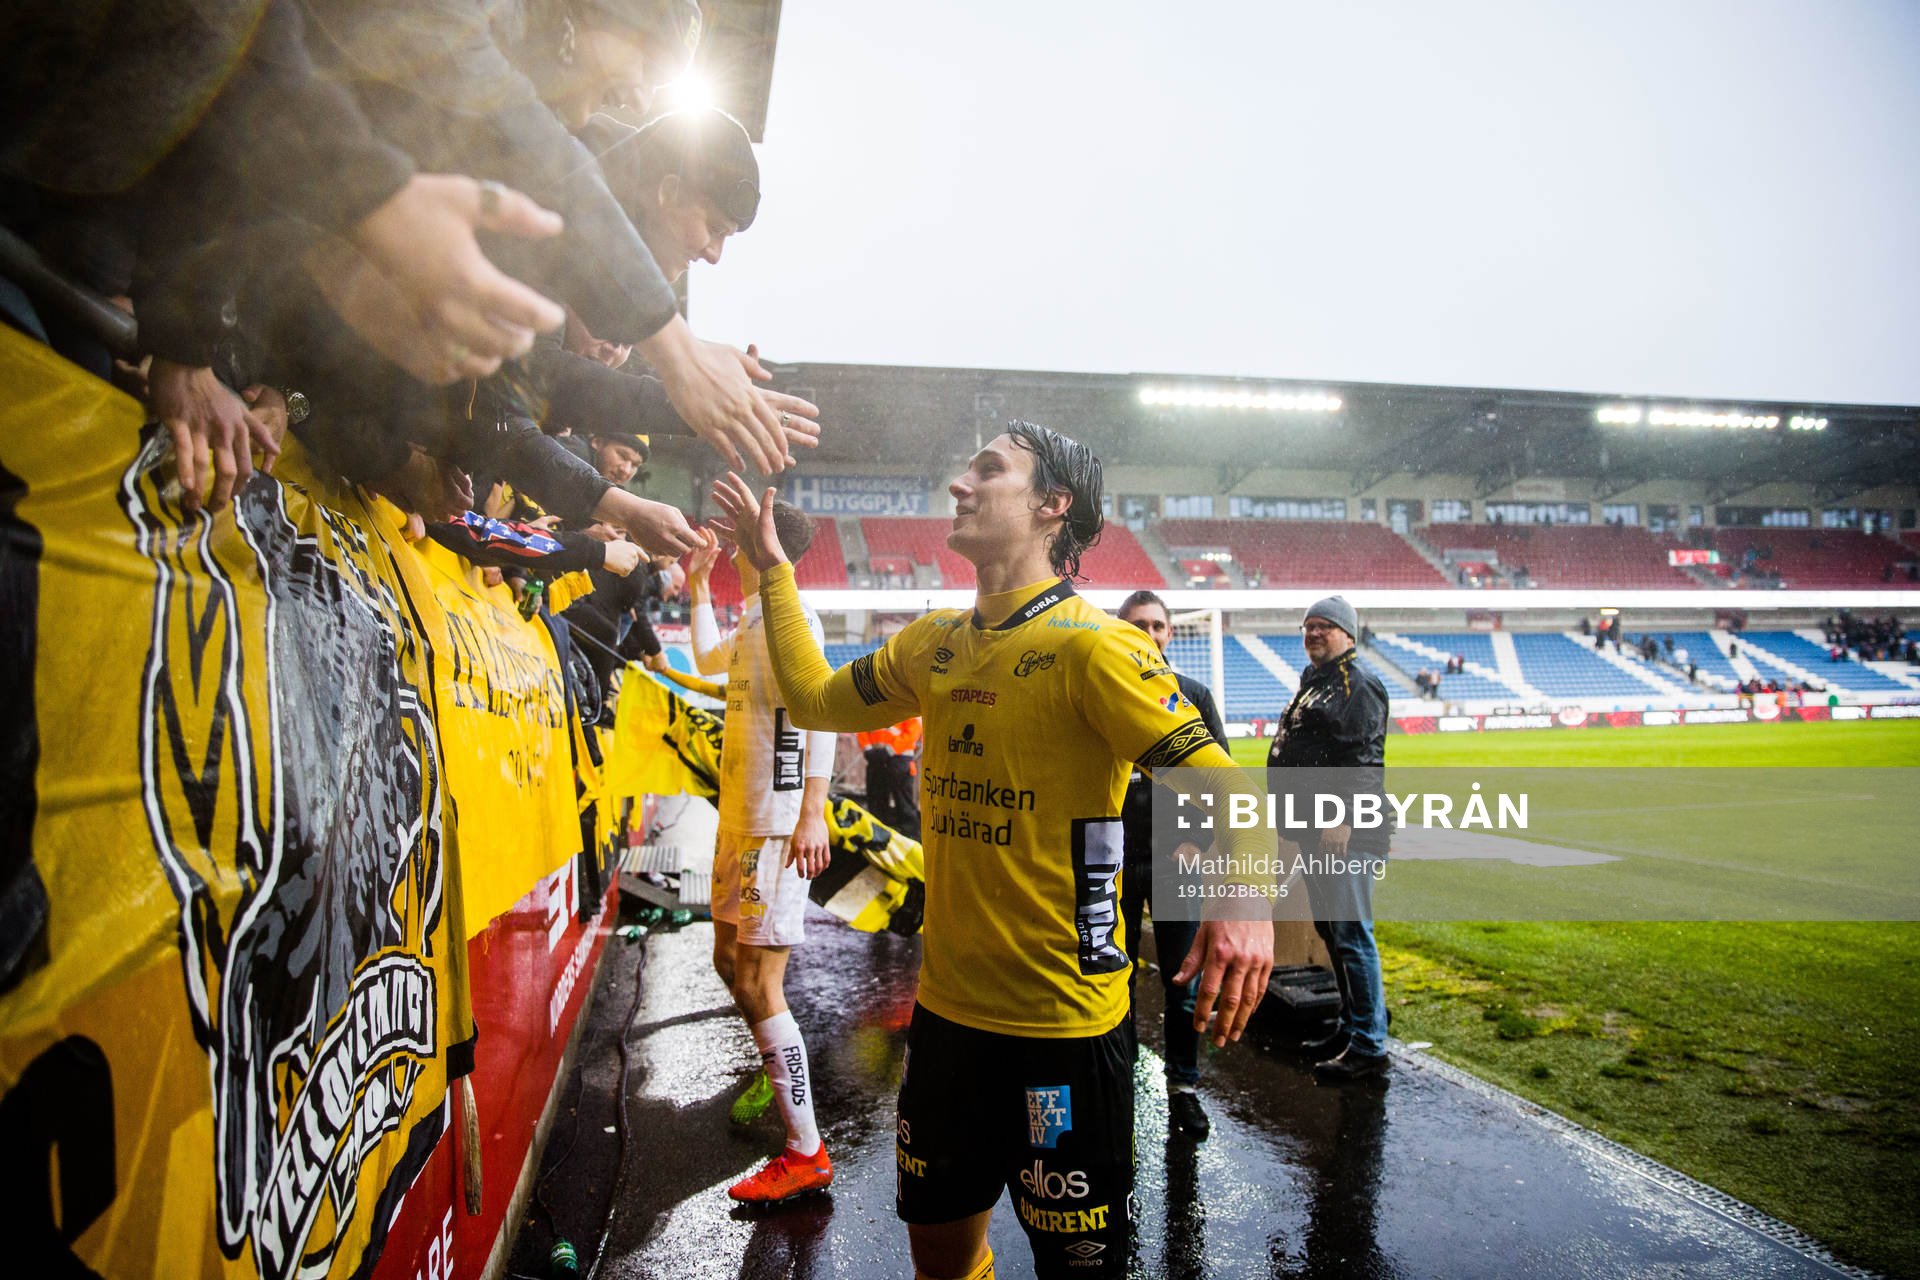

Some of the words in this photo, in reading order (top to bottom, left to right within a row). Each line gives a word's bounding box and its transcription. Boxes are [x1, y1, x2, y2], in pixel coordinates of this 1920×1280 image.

[1024, 594, 1059, 618] BORÅS
[951, 688, 997, 705] STAPLES
[948, 736, 984, 756] lamina
[782, 1045, 806, 1106] FRISTADS
[1026, 1090, 1060, 1109] EFF
[1028, 1108, 1067, 1127] EKT
[1020, 1159, 1090, 1200] ellos
[1069, 1258, 1103, 1268] umbro
